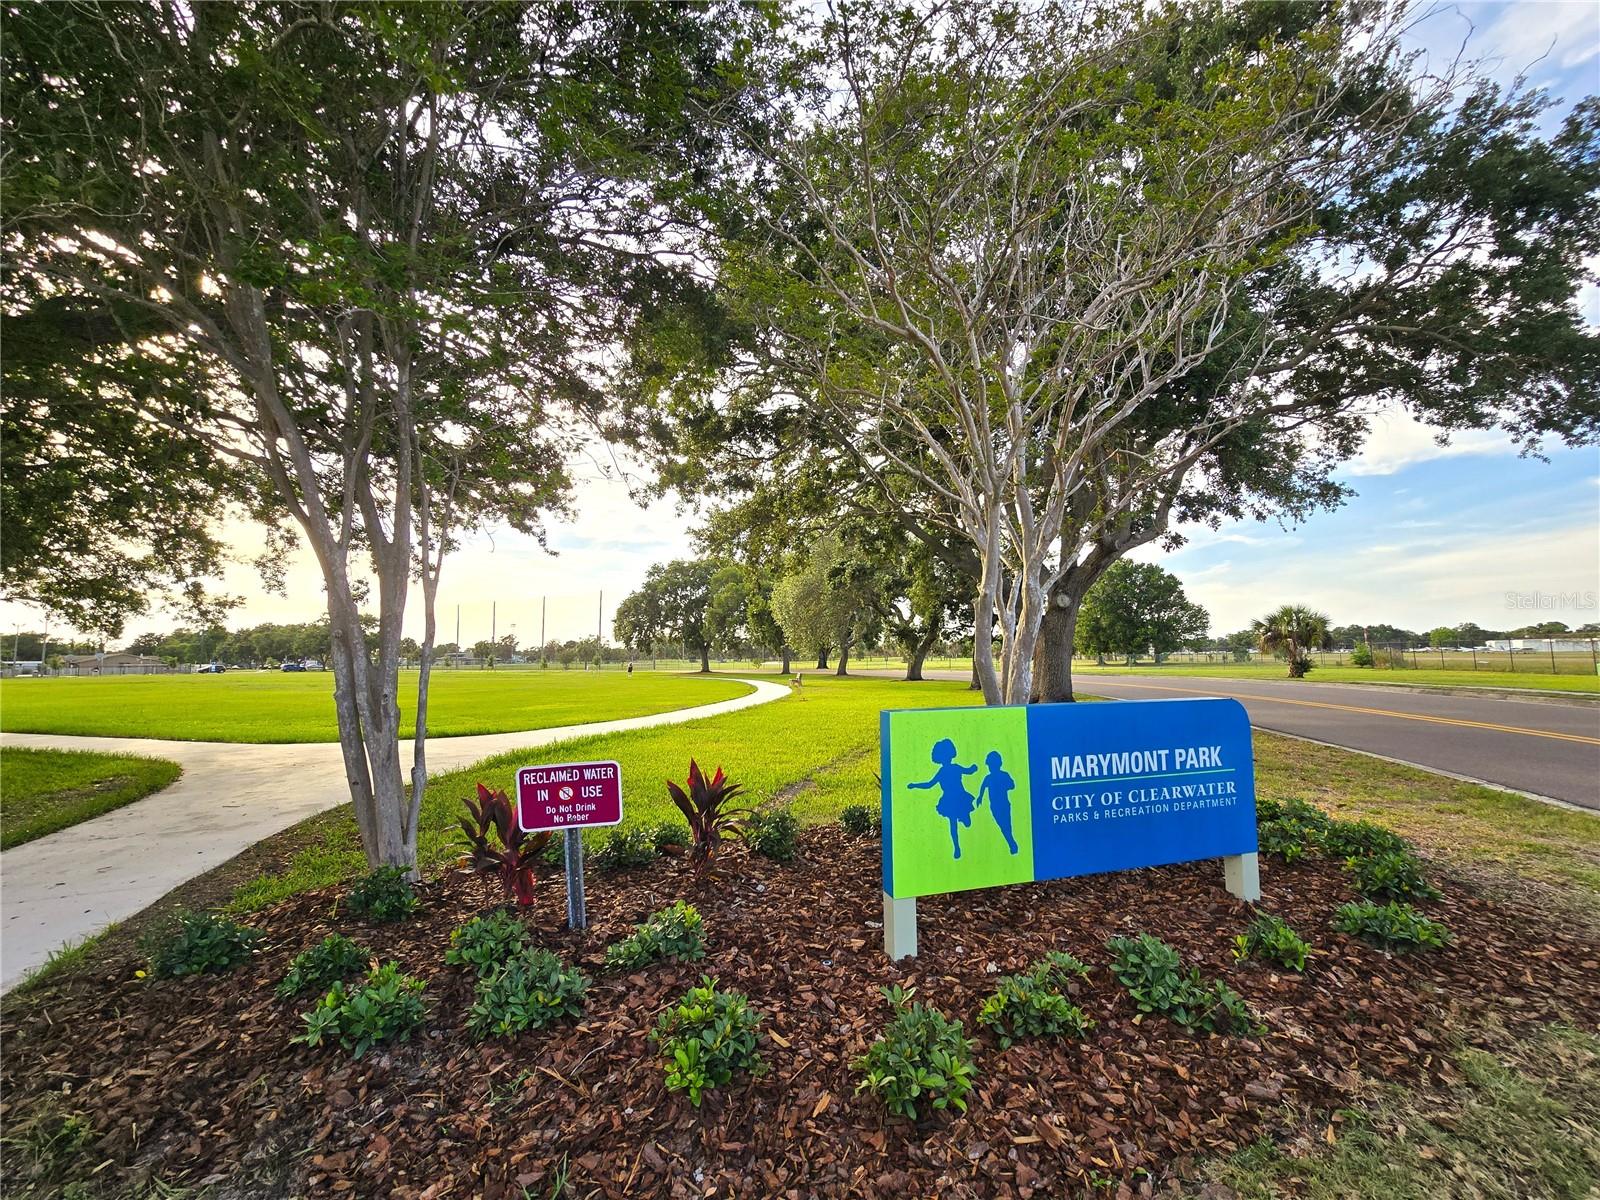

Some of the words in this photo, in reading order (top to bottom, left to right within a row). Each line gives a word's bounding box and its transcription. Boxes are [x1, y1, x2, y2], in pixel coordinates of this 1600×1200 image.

[1051, 749, 1170, 780] MARYMONT
[1174, 745, 1223, 770] PARK
[523, 770, 580, 785] RECLAIMED
[583, 767, 614, 780] WATER
[537, 789, 549, 802] IN
[581, 785, 603, 798] USE
[1051, 793, 1095, 811] CITY
[1100, 791, 1123, 806] OF
[1128, 781, 1237, 803] CLEARWATER
[545, 806, 557, 815] Do
[559, 804, 573, 813] Not
[575, 803, 596, 811] Drink
[1053, 811, 1089, 824] PARKS
[1093, 810, 1100, 820] &
[1104, 804, 1170, 819] RECREATION
[1173, 796, 1238, 811] DEPARTMENT
[553, 814, 564, 823] No
